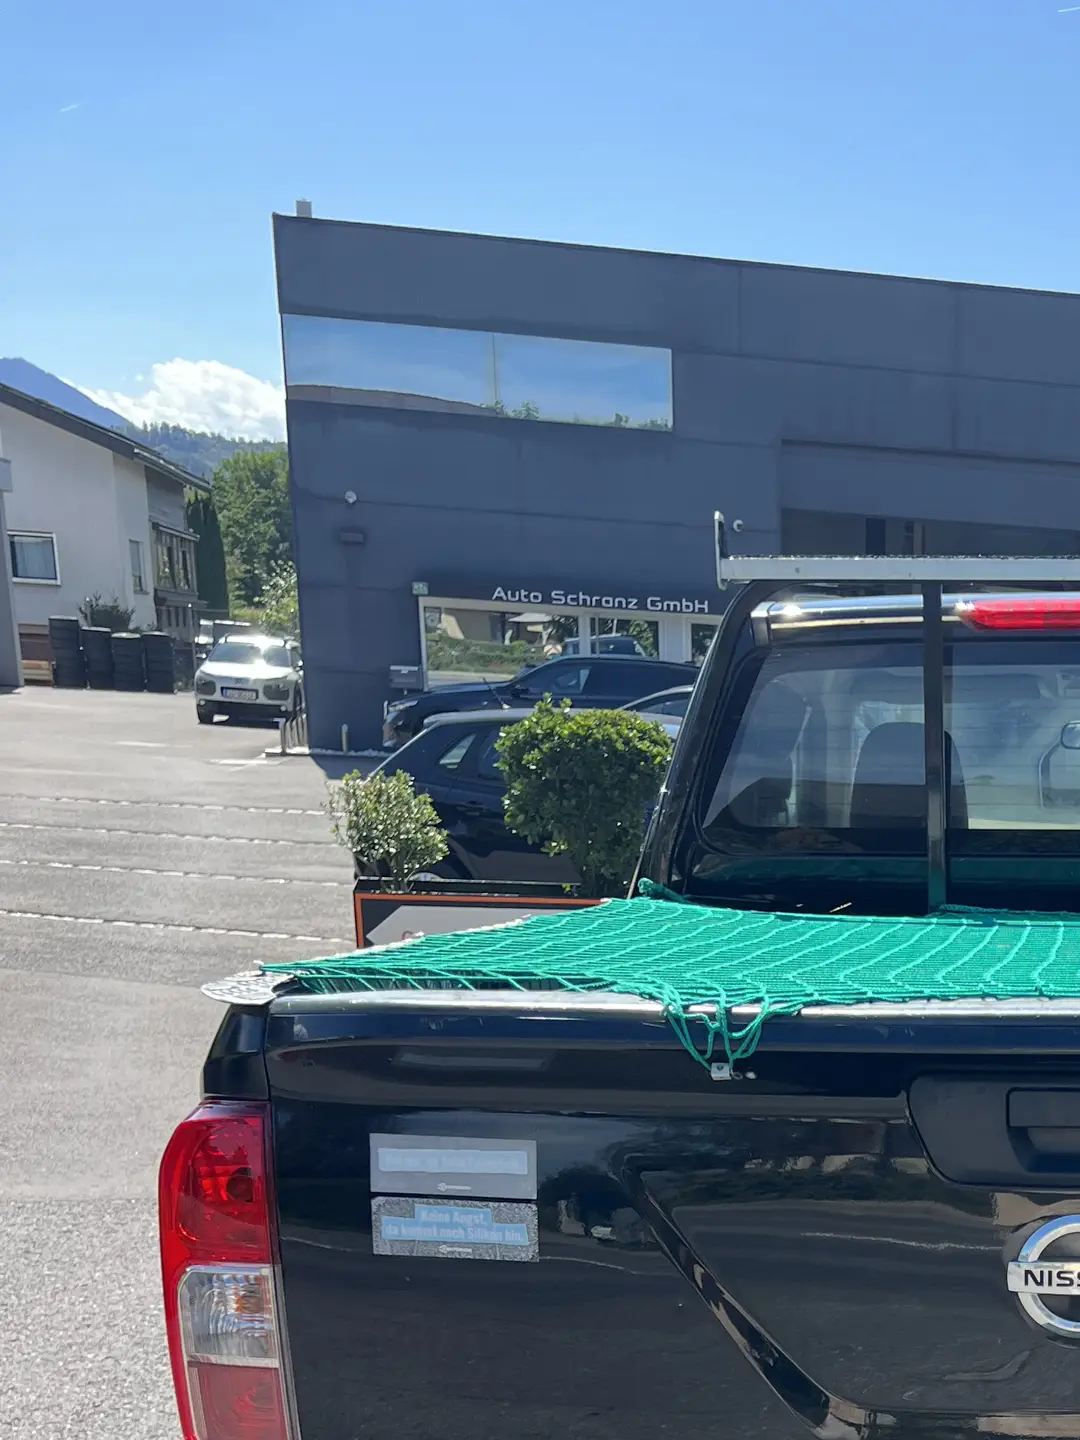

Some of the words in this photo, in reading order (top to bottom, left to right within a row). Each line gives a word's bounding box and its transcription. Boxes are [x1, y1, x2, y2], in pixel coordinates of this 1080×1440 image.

[492, 586, 543, 603] Auto
[551, 590, 638, 610] Schranz
[646, 596, 709, 614] GmbH
